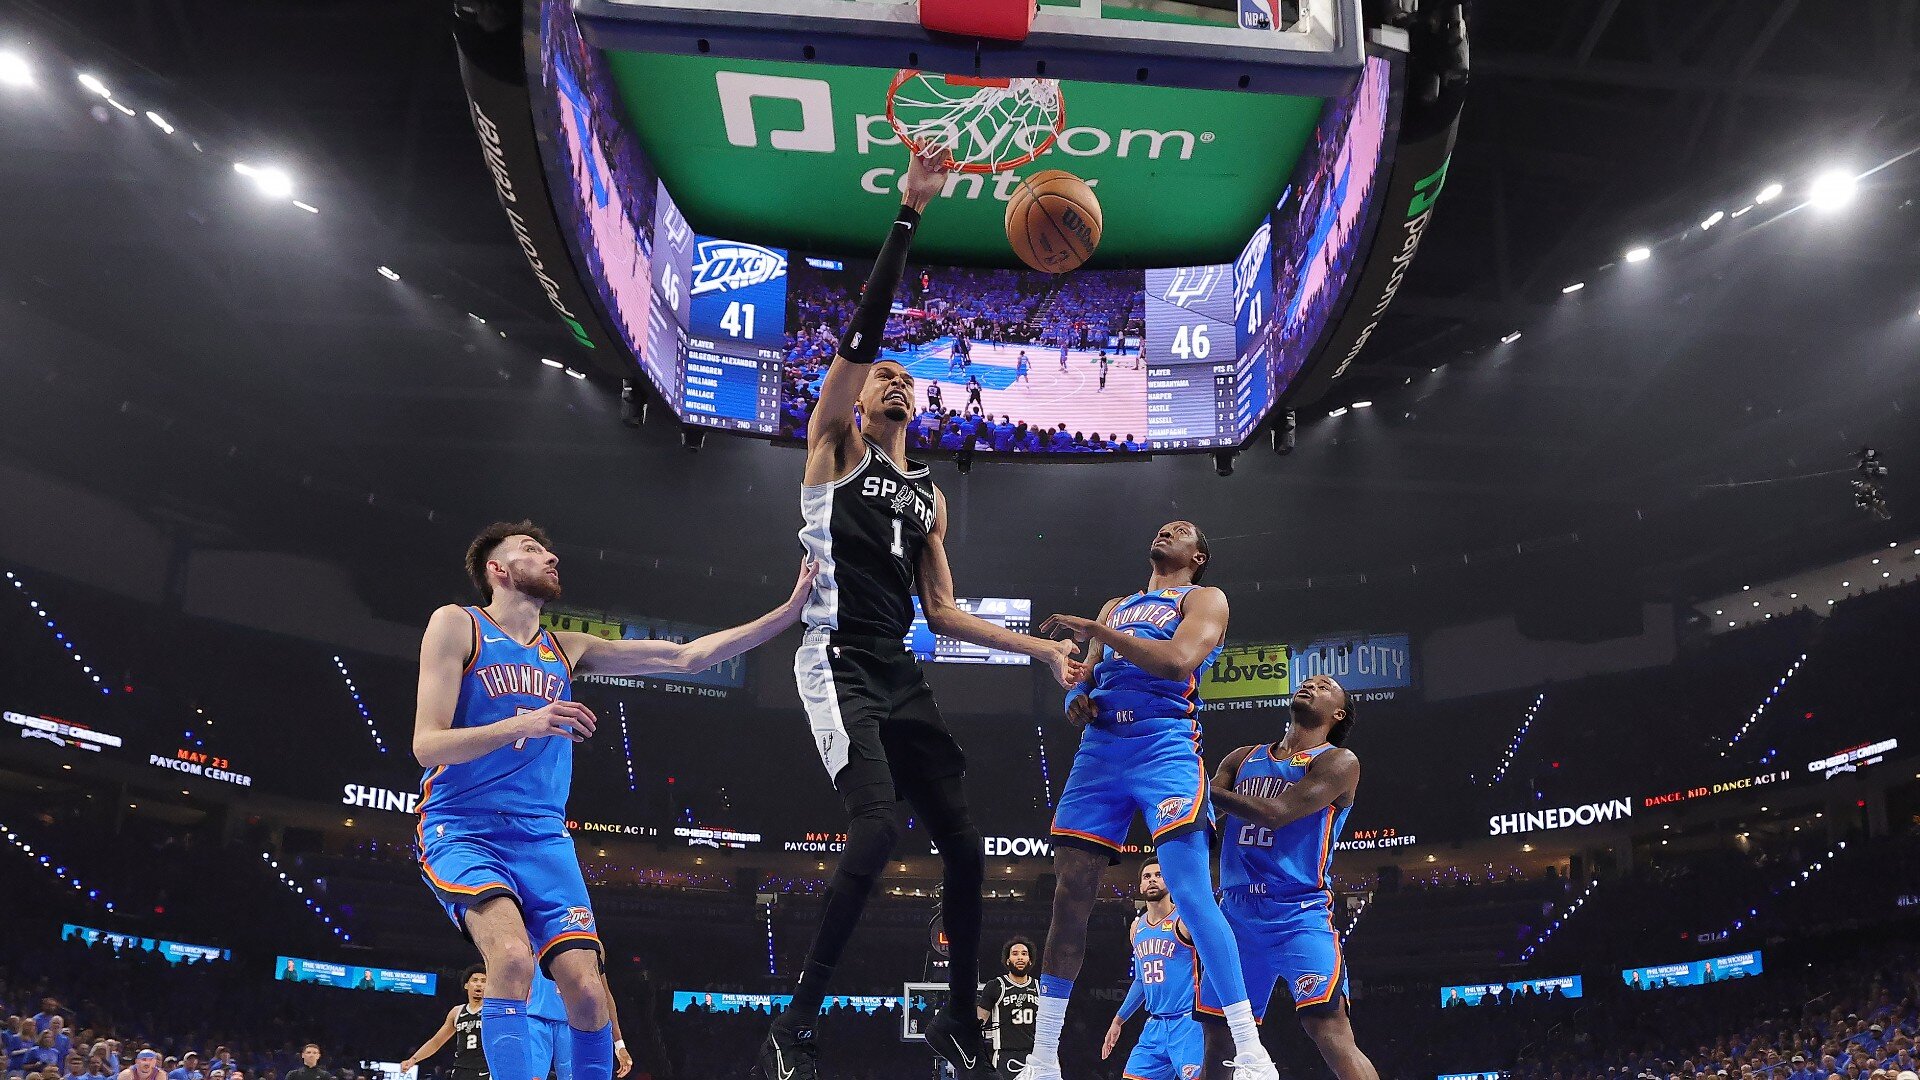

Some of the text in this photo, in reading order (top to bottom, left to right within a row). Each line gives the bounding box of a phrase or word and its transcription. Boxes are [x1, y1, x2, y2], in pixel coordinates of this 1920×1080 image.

[661, 262, 680, 311] 46
[719, 301, 755, 340] 41
[690, 338, 781, 360] PLAYER PTS FL
[1170, 324, 1211, 360] 46
[687, 363, 723, 376] HOLMGREN
[761, 374, 766, 382] 2
[762, 362, 767, 370] 4
[1148, 365, 1235, 377] PLAYER PTS FL
[686, 375, 718, 388] WILLIAMS
[772, 388, 777, 396] 2
[1216, 377, 1225, 385] 12
[686, 387, 715, 400] WALLACE
[1148, 392, 1172, 401] HARPER
[1218, 389, 1223, 397] 7
[685, 400, 716, 413] MITCHELL
[1148, 404, 1170, 412] CASTLE
[1217, 401, 1225, 409] 11
[737, 420, 750, 430] 2ND
[1148, 416, 1173, 425] VASSELL
[890, 519, 904, 558] 1
[1357, 645, 1405, 680] CITY
[476, 663, 565, 703] THUNDER
[584, 674, 645, 689] THUNDER
[665, 683, 695, 695] EXIT
[698, 687, 727, 699] NOW
[1229, 700, 1253, 710] THE
[1258, 697, 1294, 708] THUN
[1366, 691, 1395, 701] NOW
[1116, 710, 1134, 723] OKC
[177, 748, 229, 769] MAY 23
[149, 754, 252, 787] PAYCOM CENTER
[1235, 777, 1295, 799] THUND
[1688, 786, 1712, 799] KID,
[1713, 778, 1752, 794] DANCE
[1754, 772, 1777, 786] ACT
[343, 783, 420, 815] SHINE
[1490, 797, 1632, 836] SHINEDOWN
[566, 820, 581, 831] ID,
[584, 821, 622, 833] DANCE
[623, 824, 644, 835] ACT
[1354, 828, 1395, 839] MAY 23
[806, 832, 847, 842] MAY 23
[1333, 835, 1416, 851] PAYCOM CENTER
[784, 841, 826, 852] PAYCOM
[1143, 959, 1165, 984] 25
[721, 993, 770, 1002] PHIL WICKHAM
[1011, 1008, 1034, 1025] 30
[456, 1019, 482, 1033] SPUR
[466, 1034, 478, 1050] 2
